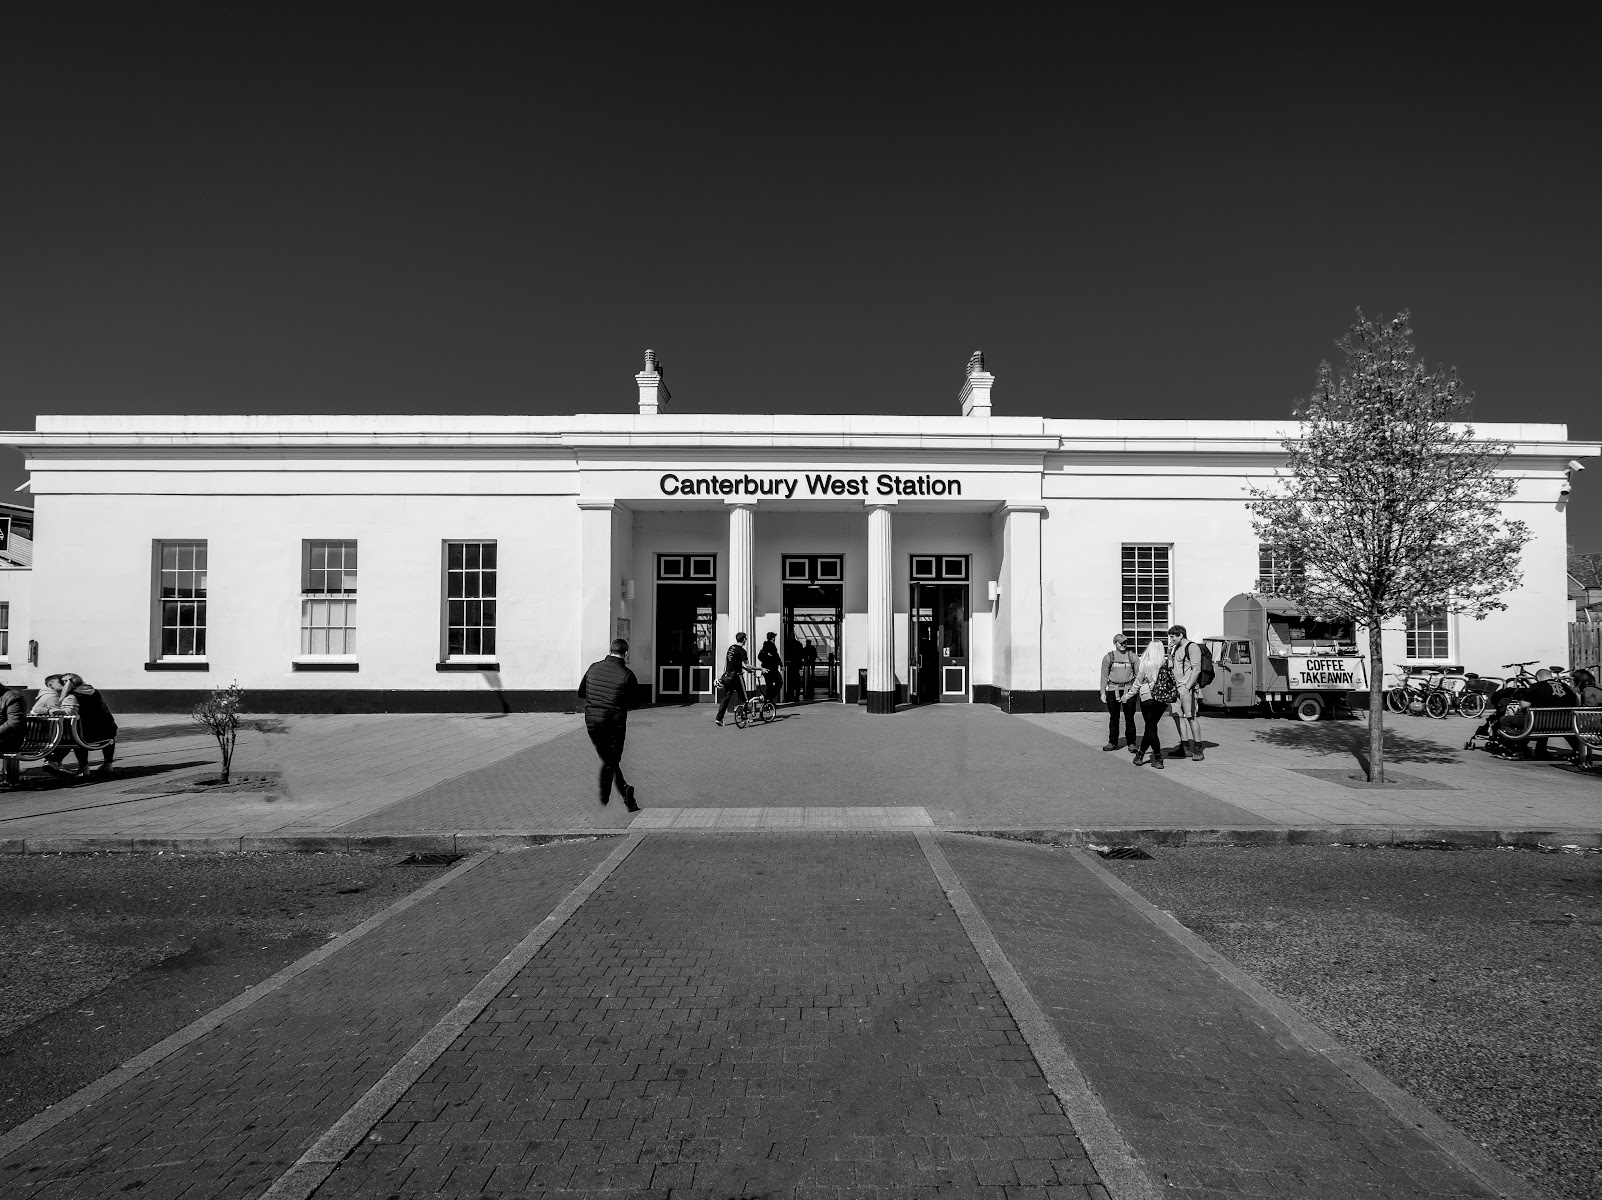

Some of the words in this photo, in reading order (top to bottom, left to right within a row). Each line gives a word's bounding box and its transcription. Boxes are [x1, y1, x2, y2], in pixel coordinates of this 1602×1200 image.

[660, 474, 798, 498] Canterbury
[805, 474, 869, 496] West
[876, 474, 962, 496] Station
[1306, 659, 1346, 671] COFFEE
[1299, 672, 1354, 684] TAKEAWAY
